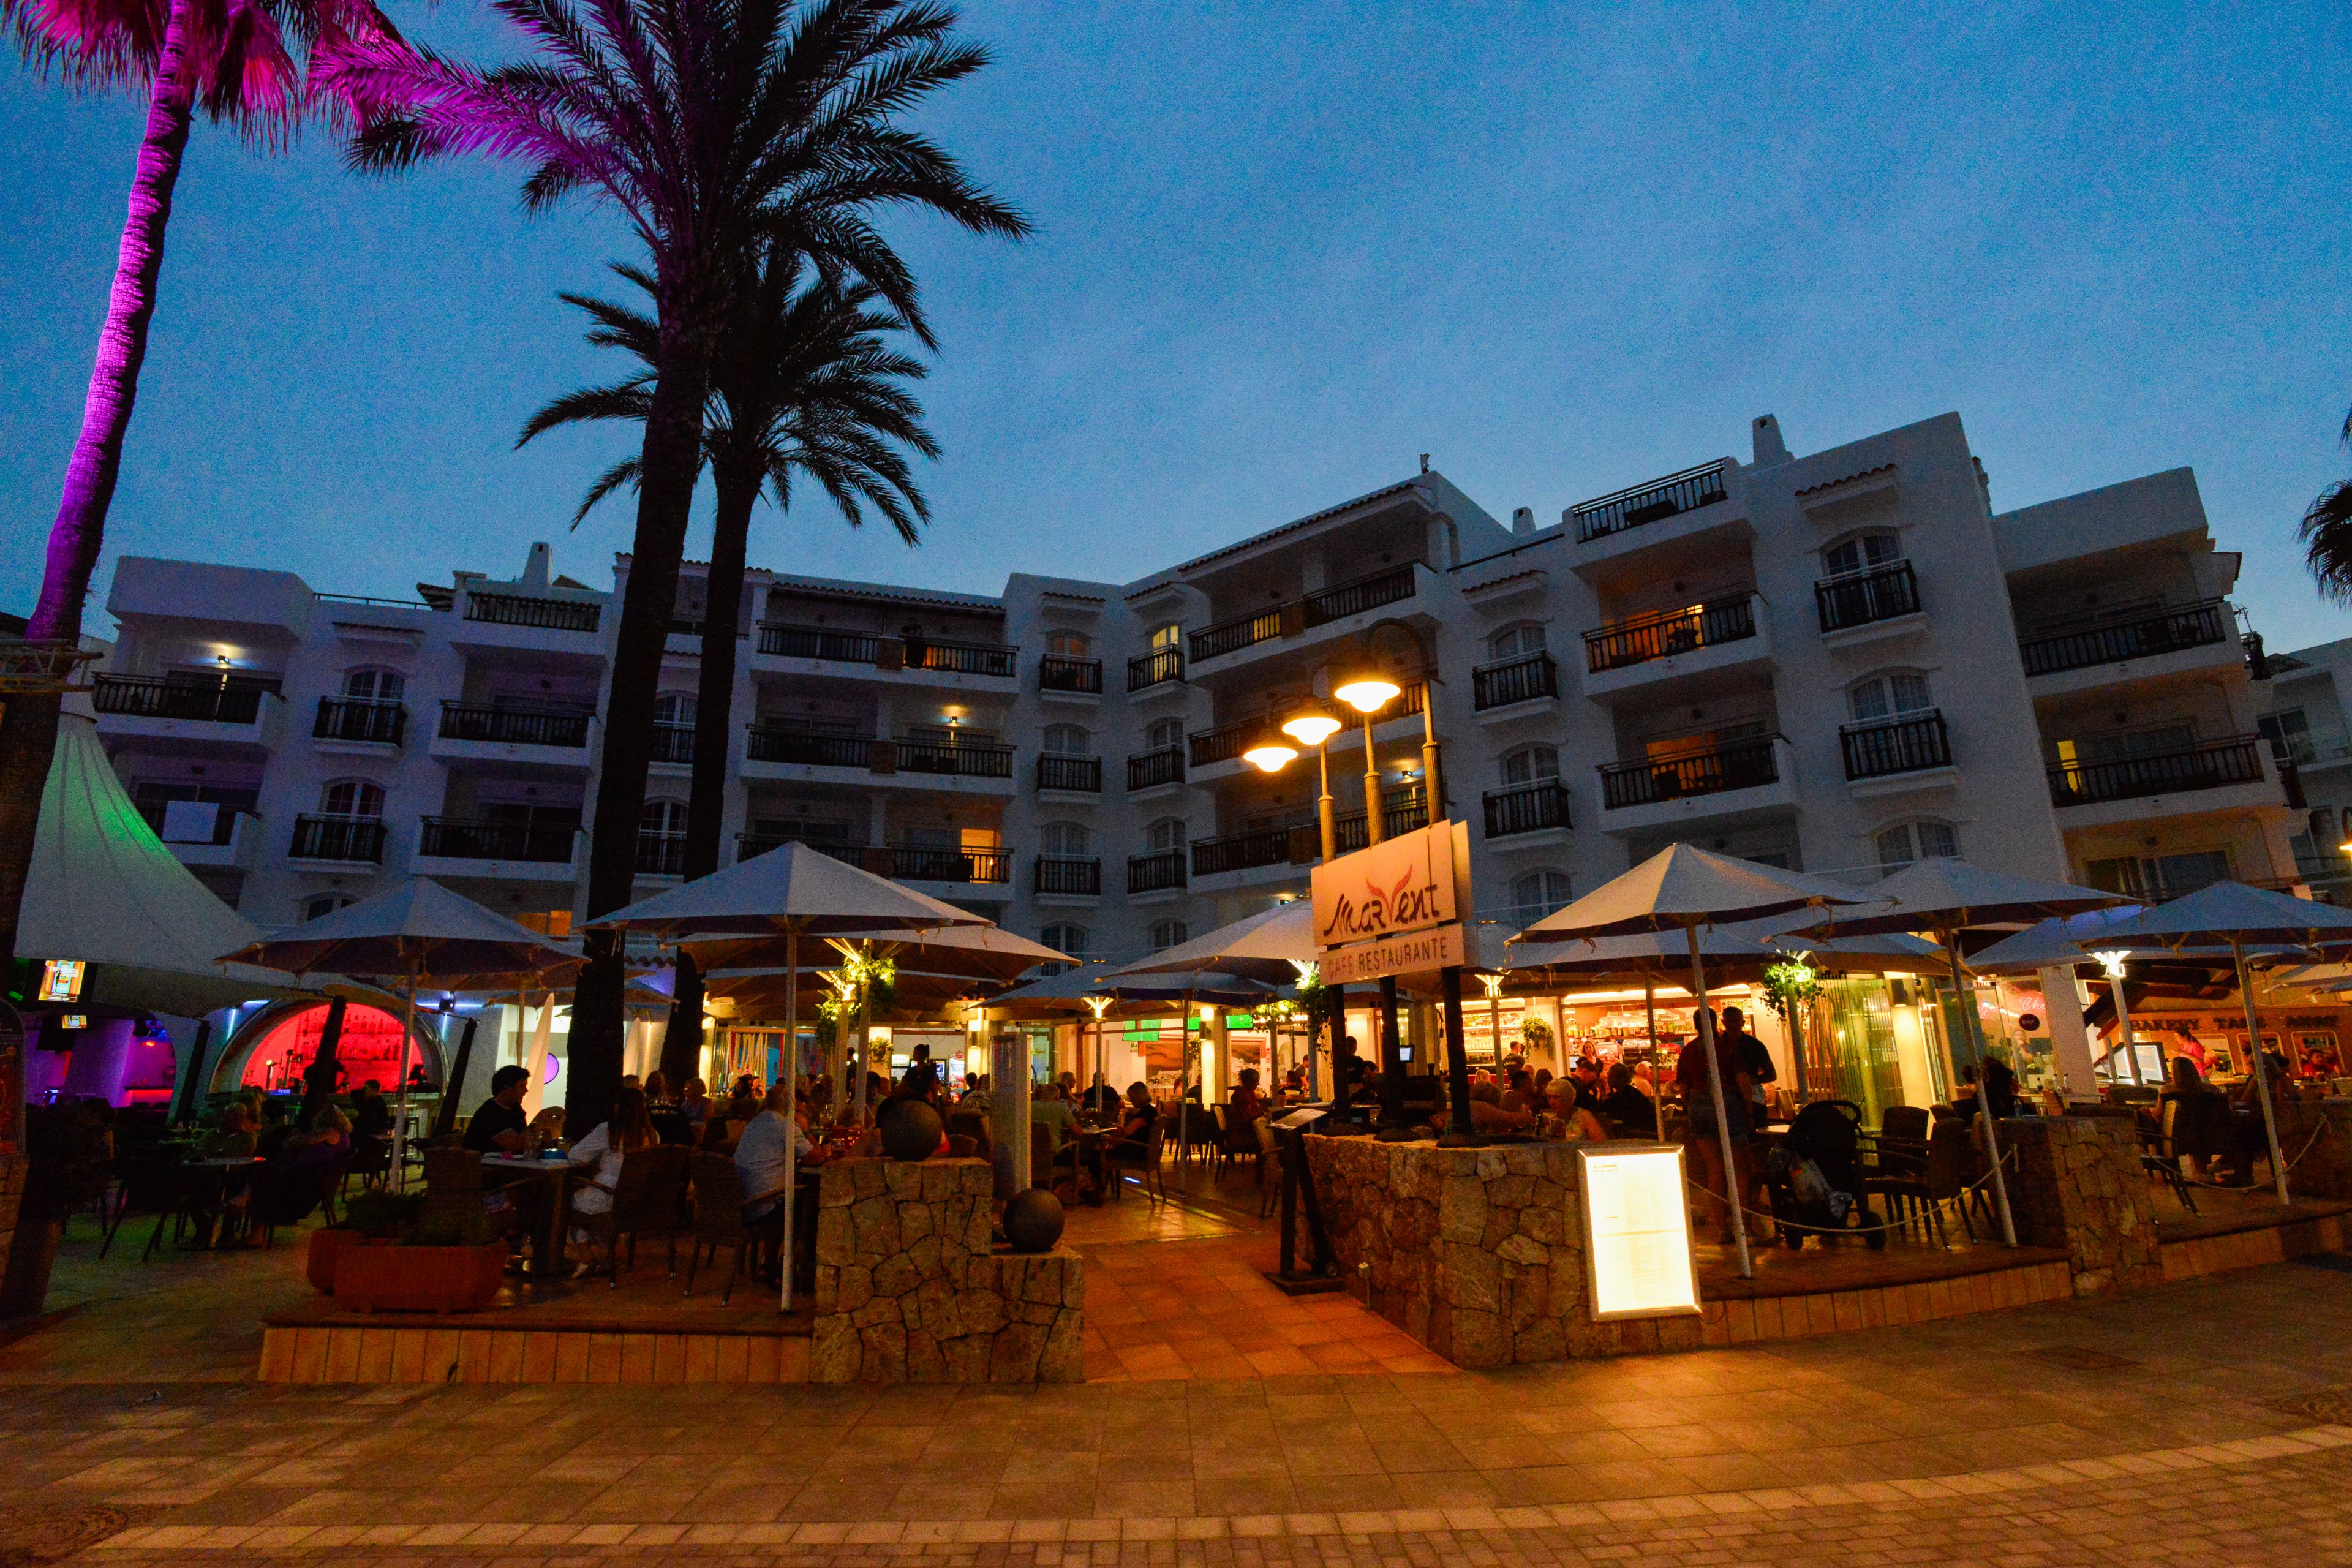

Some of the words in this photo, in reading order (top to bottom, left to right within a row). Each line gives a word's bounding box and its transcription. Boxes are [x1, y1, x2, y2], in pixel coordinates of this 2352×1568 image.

[1328, 955, 1353, 978] CAFE
[1359, 937, 1447, 971] RESTAURANTE
[2130, 1019, 2200, 1031] BAKERY
